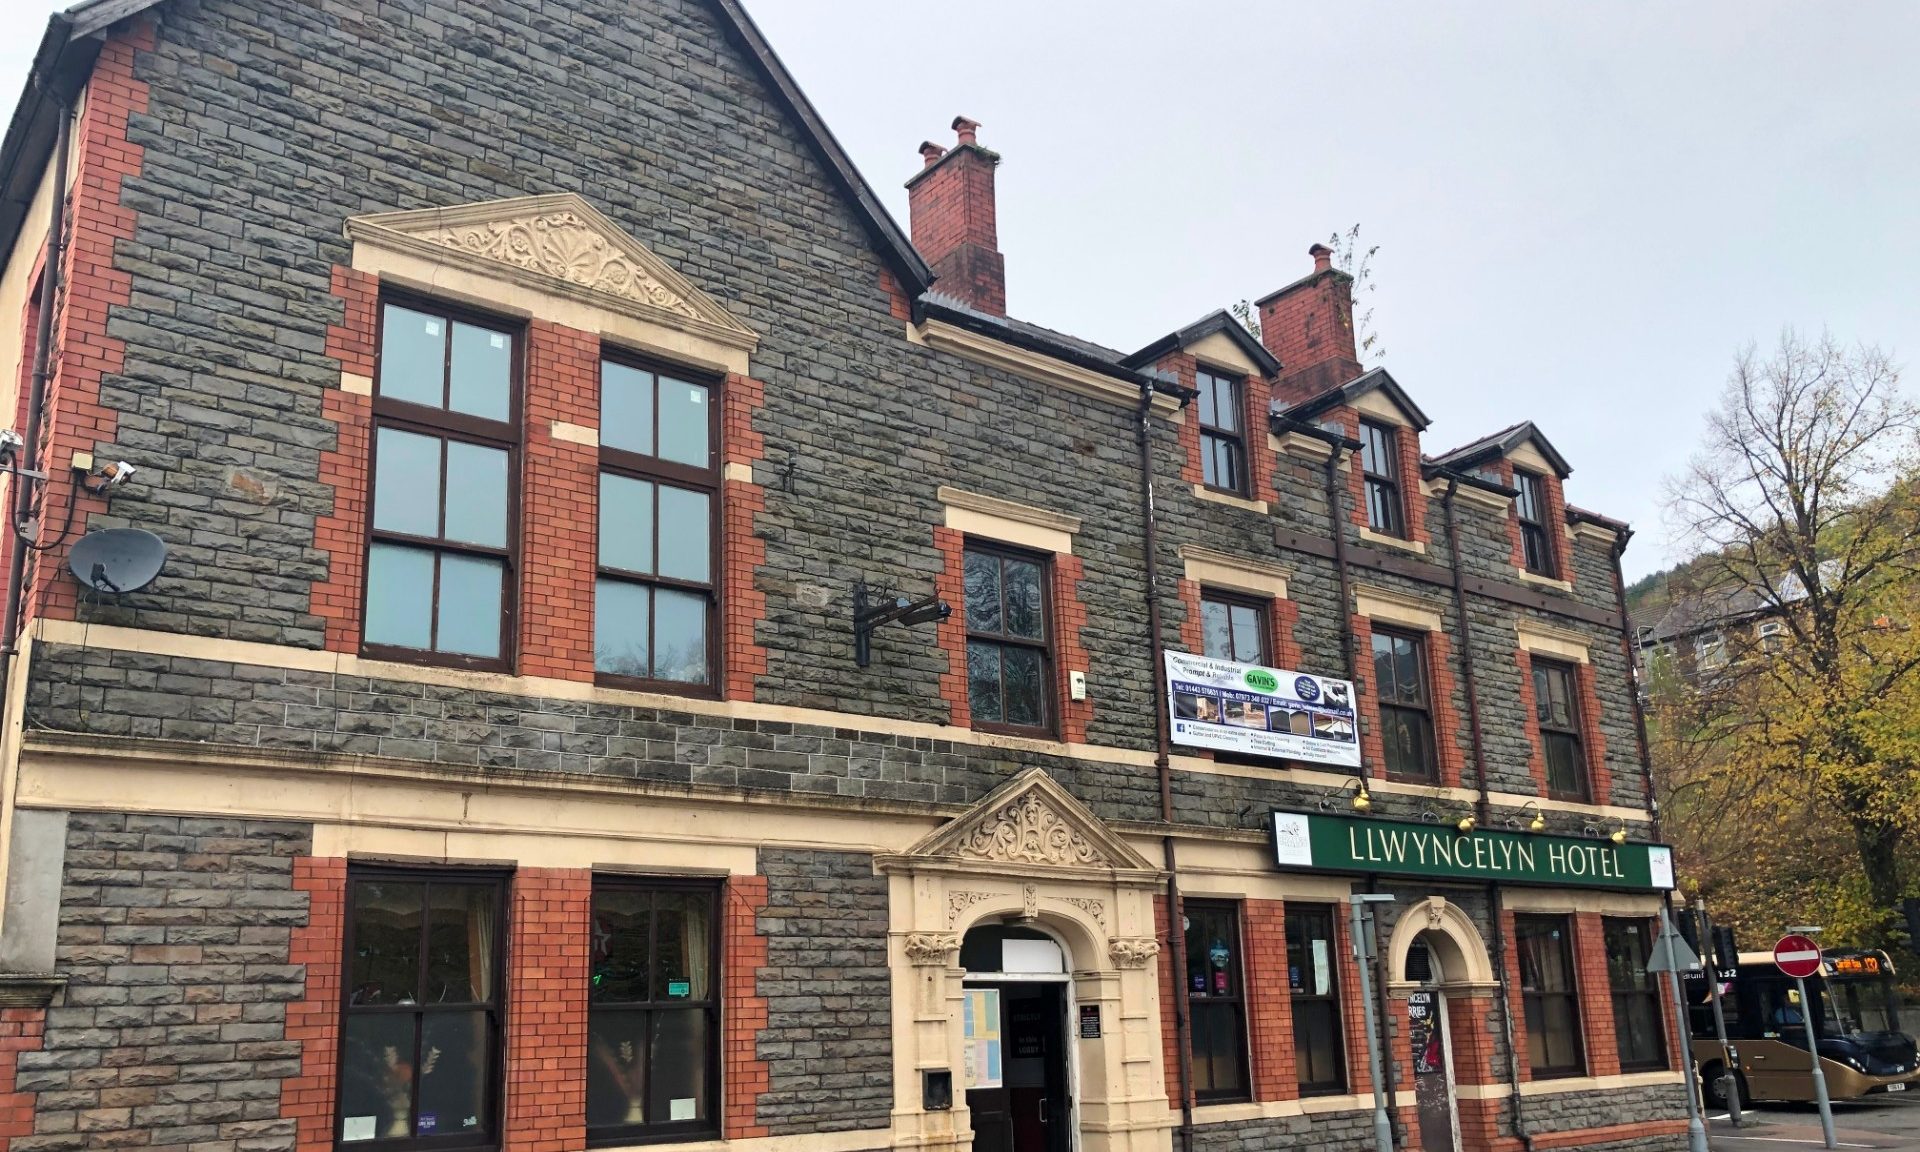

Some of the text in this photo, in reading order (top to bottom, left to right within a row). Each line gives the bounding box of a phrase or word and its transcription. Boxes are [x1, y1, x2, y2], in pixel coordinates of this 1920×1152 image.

[1182, 666, 1206, 677] Prompt
[1214, 663, 1242, 674] Industrial
[1246, 674, 1275, 687] GAVIN'S
[1349, 826, 1625, 878] LLWYNCELYN HOTEL
[1408, 1006, 1426, 1018] RRIES
